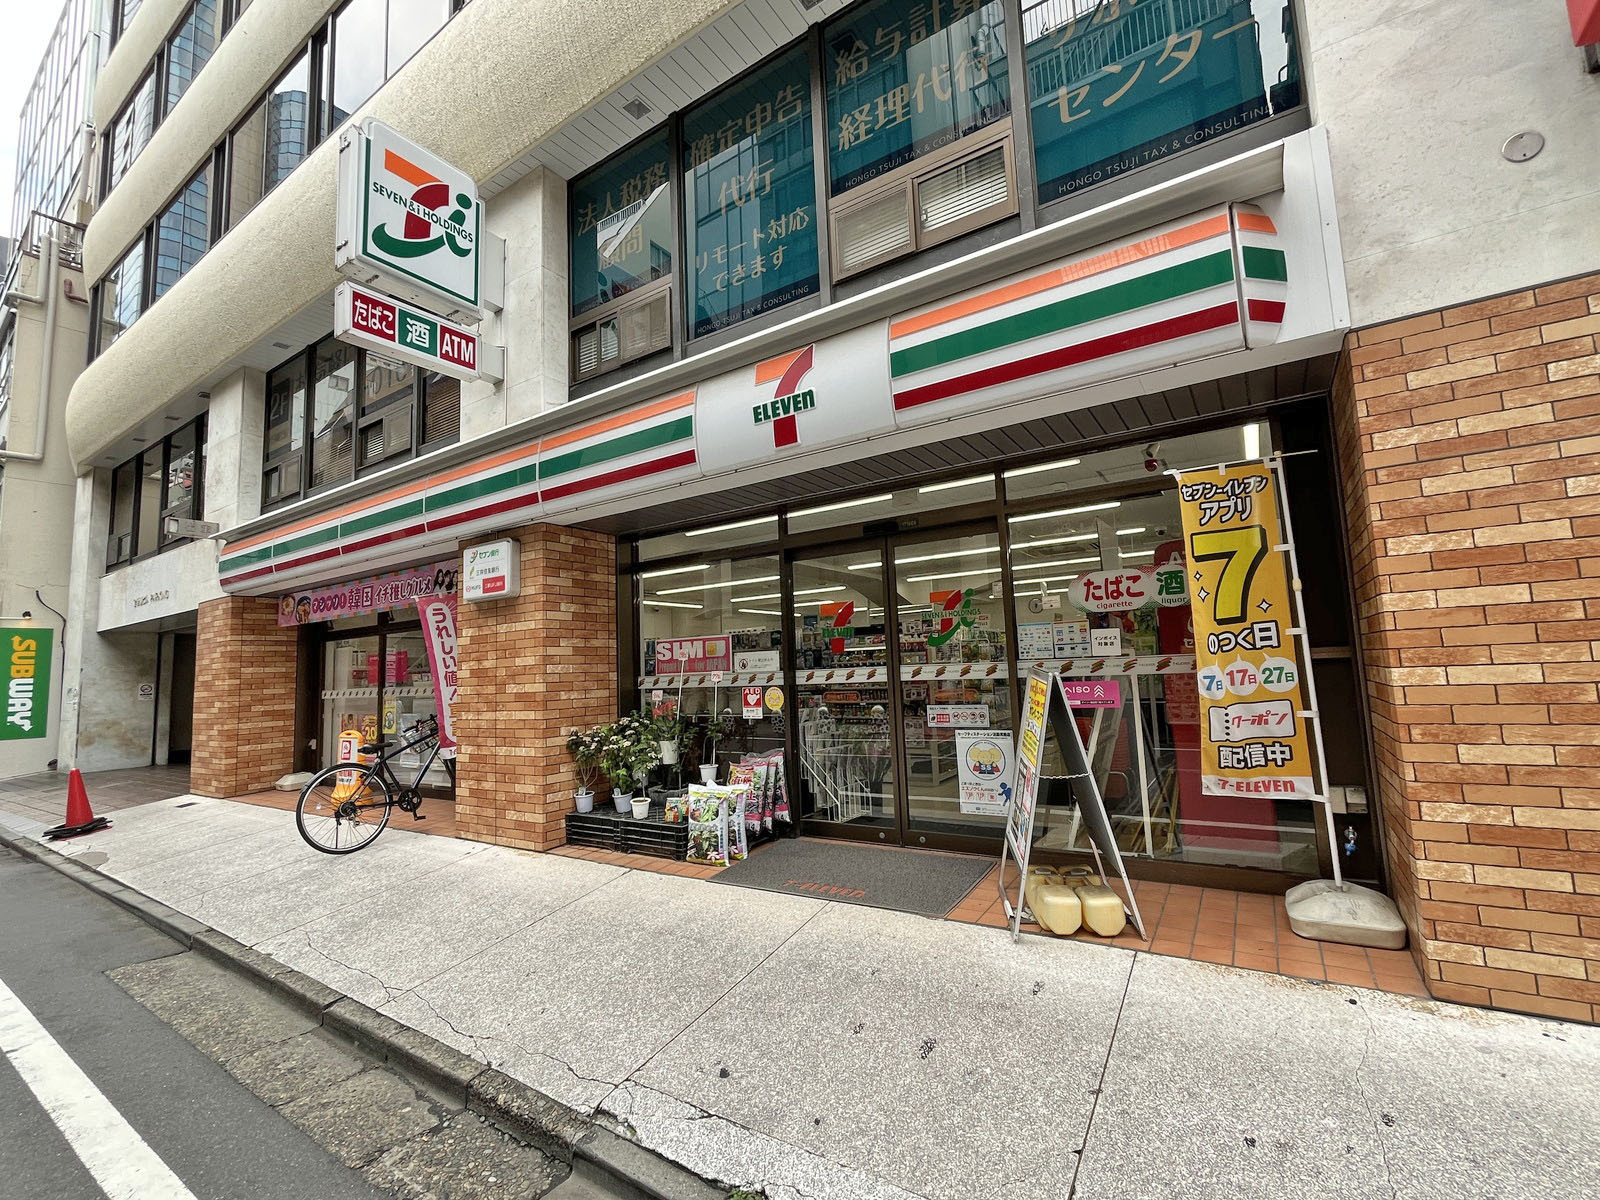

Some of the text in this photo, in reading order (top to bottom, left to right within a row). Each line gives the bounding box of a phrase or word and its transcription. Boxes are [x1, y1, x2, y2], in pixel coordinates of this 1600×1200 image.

[1048, 16, 1255, 124] センター
[838, 38, 993, 151] 経理代行
[690, 84, 805, 168] 確定申告
[845, 168, 876, 188] HONGO
[878, 157, 902, 174] TSUJI
[904, 150, 921, 163] TAX
[924, 143, 930, 152] &
[1058, 171, 1102, 194] HONGO
[1106, 157, 1139, 177] TSUJI
[1143, 145, 1168, 161] TAX
[1172, 139, 1181, 150] &
[577, 161, 667, 237] 法人税務
[718, 158, 775, 216] 代行
[423, 209, 474, 244] HOLDINGS
[695, 205, 810, 275] リモート対応
[712, 244, 787, 292] できます
[354, 298, 394, 335] たばこ
[697, 318, 721, 334] HONGO
[742, 305, 756, 318] TAX
[763, 284, 810, 309] CONSULTING
[405, 317, 430, 349] 酒
[441, 331, 474, 366] ATM
[1199, 495, 1252, 527] アプリ
[1083, 574, 1145, 603] たばこ
[1155, 569, 1186, 596] 酒
[1190, 524, 1269, 626] 7
[948, 608, 982, 618] HOLDINGS
[1096, 600, 1133, 610] cigarette
[1161, 596, 1187, 605] liquor
[657, 639, 704, 661] SIM
[1207, 620, 1281, 655] のつく日
[7, 635, 37, 732] SUBWAY
[1064, 685, 1091, 694] AISO
[1202, 675, 1223, 691] 7日
[1226, 669, 1257, 687] 17日
[1261, 667, 1295, 684] 27日
[1231, 709, 1289, 729] クーポン
[1218, 741, 1293, 770] 配信中
